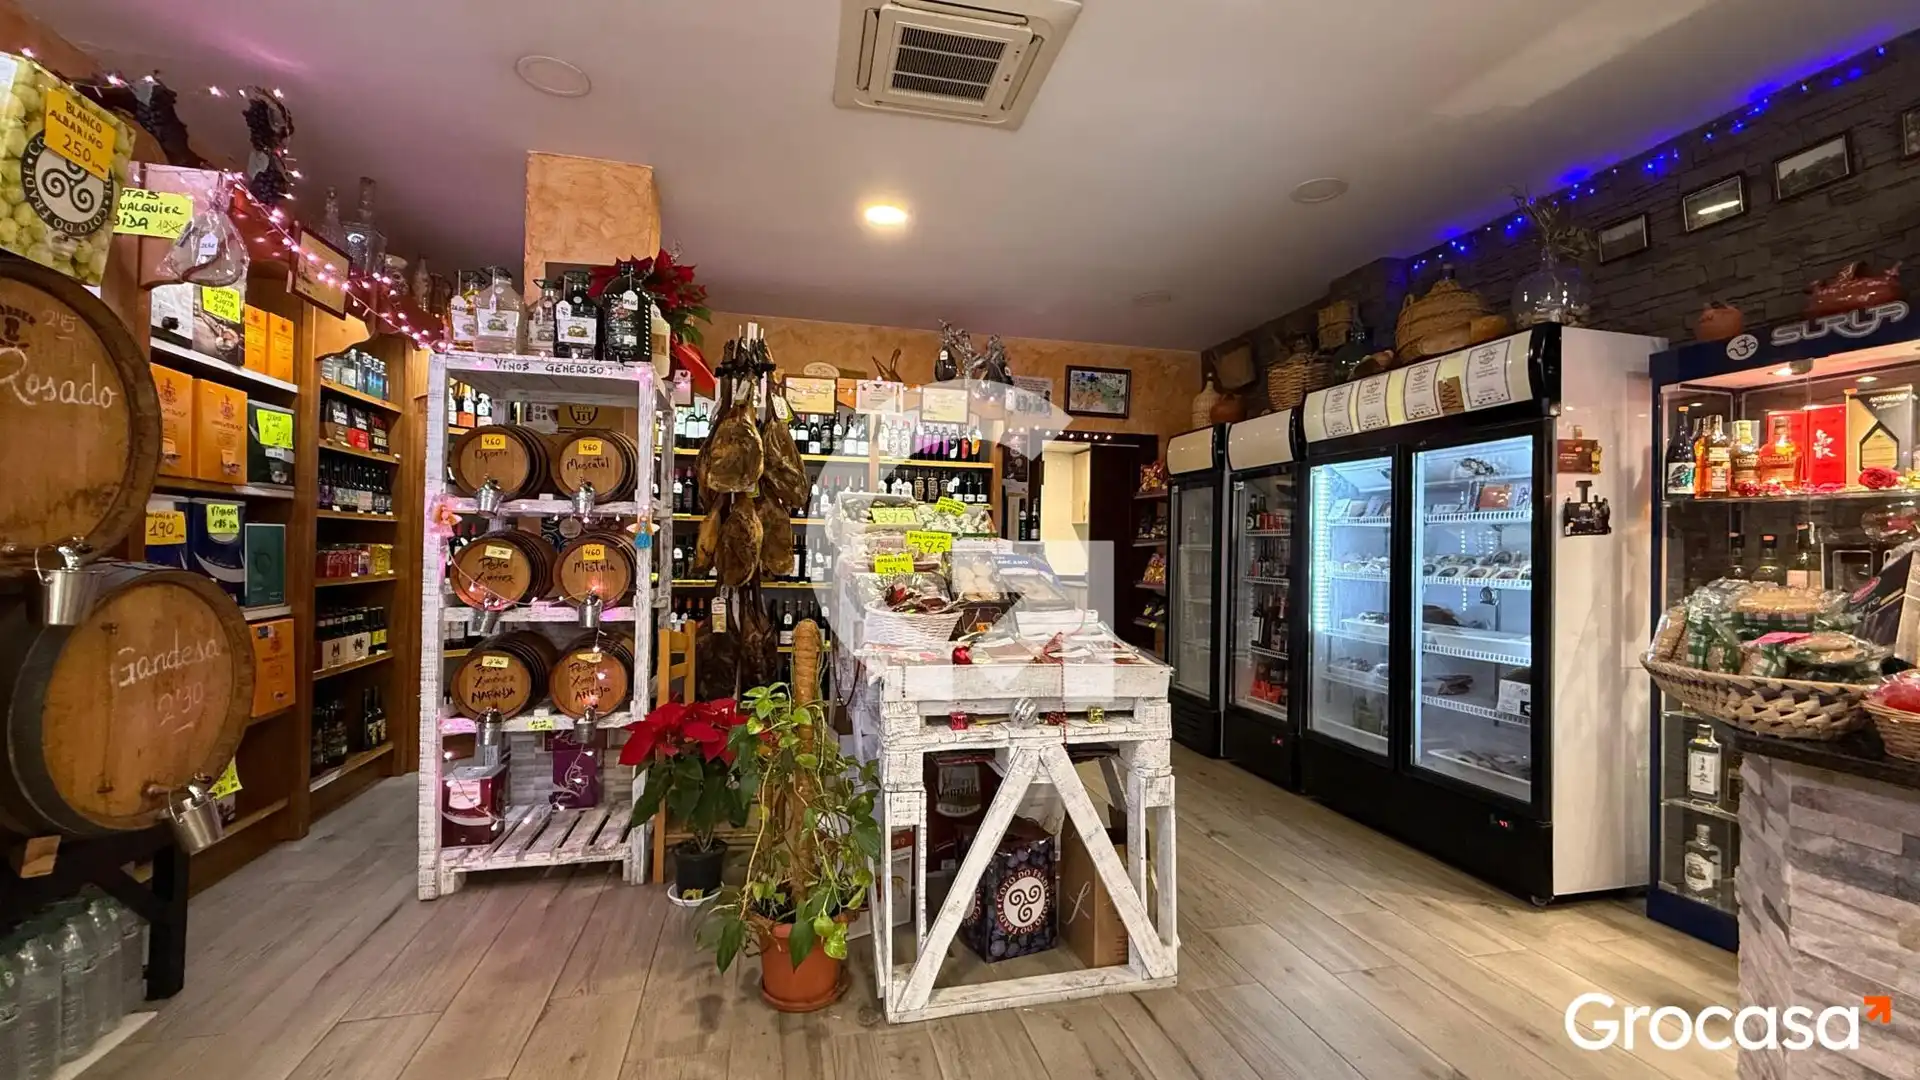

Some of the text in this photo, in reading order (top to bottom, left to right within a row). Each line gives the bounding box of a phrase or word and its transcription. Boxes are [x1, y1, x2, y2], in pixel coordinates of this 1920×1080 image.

[65, 101, 102, 133] BLANCO
[0, 346, 119, 409] Rosado
[149, 521, 176, 539] 190
